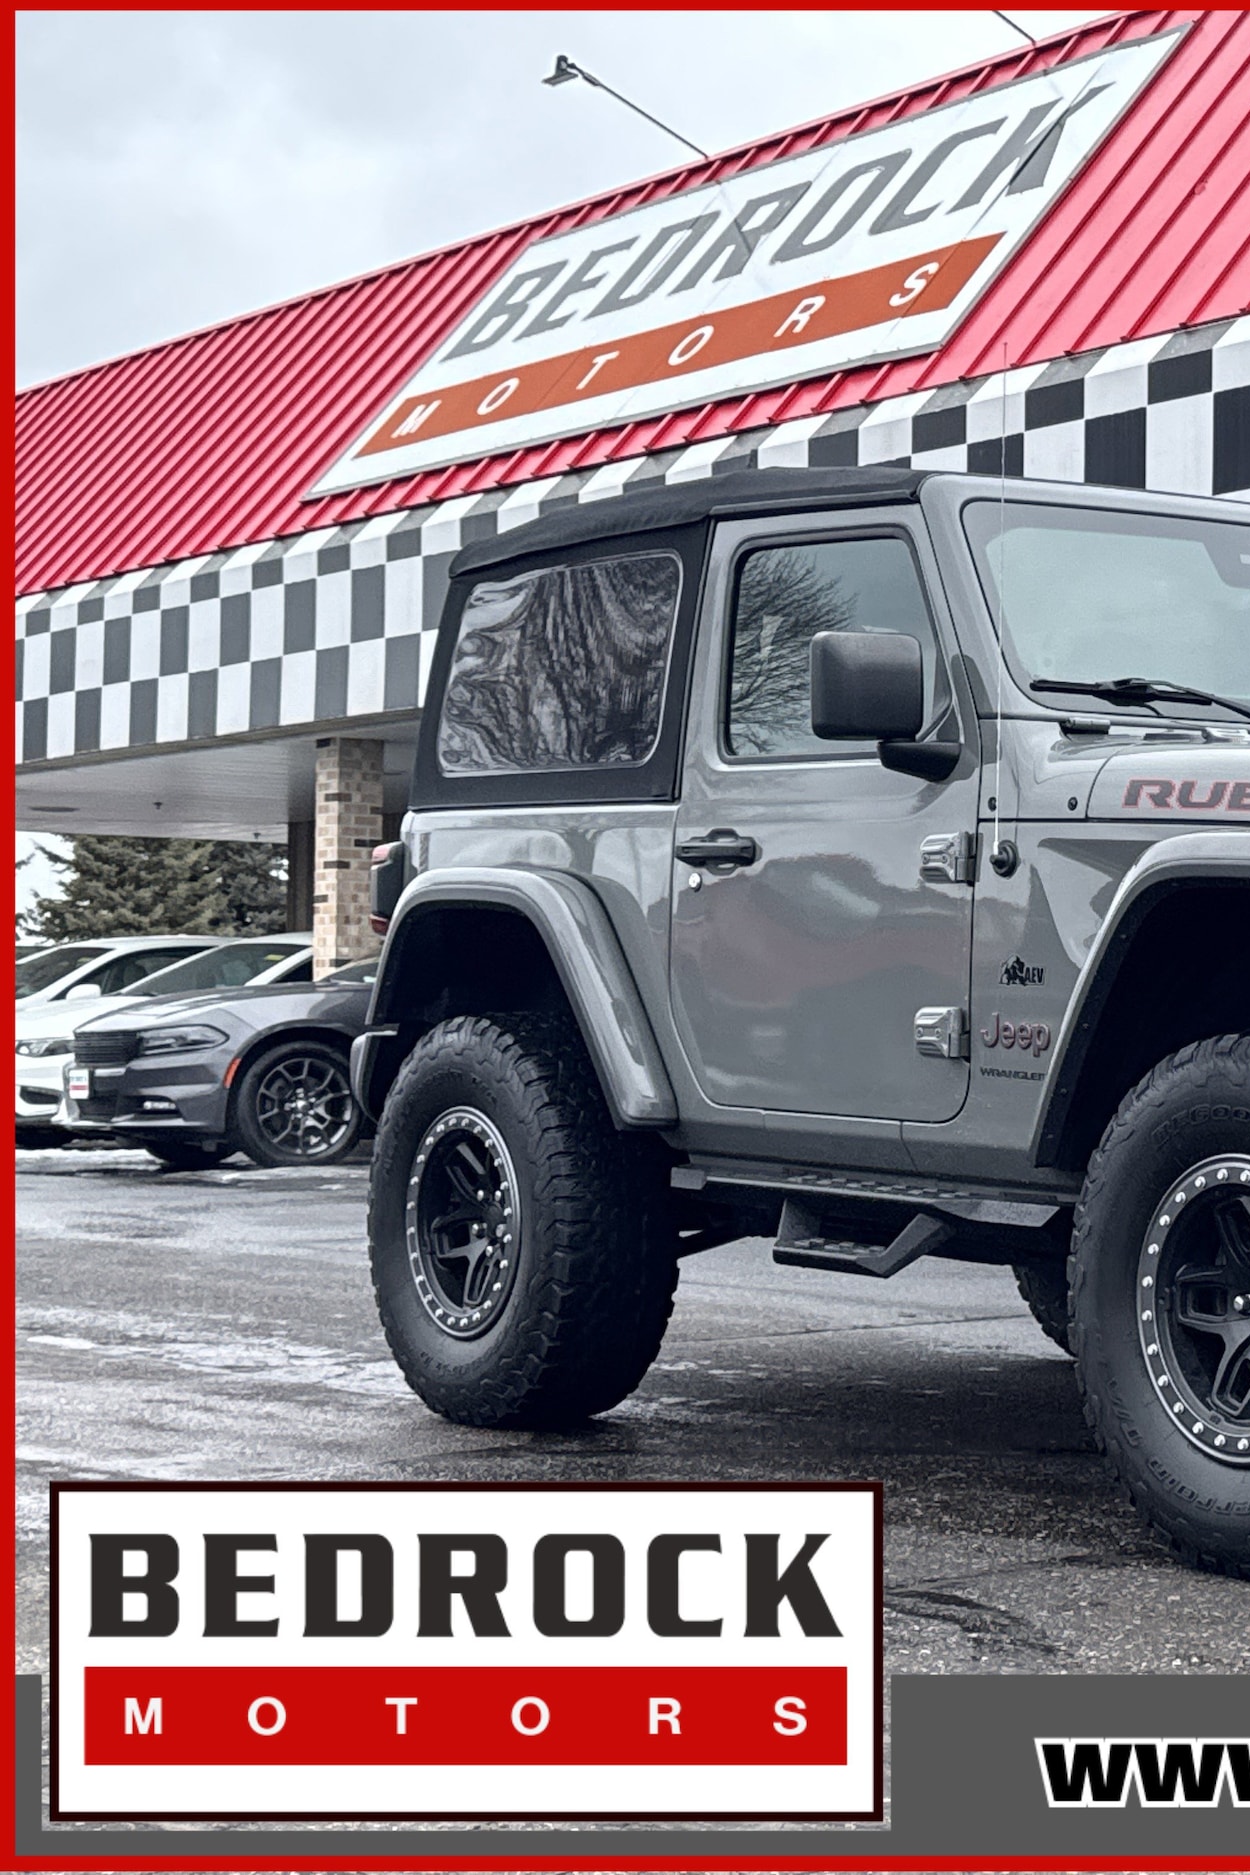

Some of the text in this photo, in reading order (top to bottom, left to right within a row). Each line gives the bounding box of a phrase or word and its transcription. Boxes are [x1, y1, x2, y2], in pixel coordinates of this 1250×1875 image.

[440, 81, 1115, 363] BEDROCK
[391, 261, 940, 439] MOTORS
[1025, 967, 1044, 984] AEV
[980, 1012, 1051, 1058] Jeep
